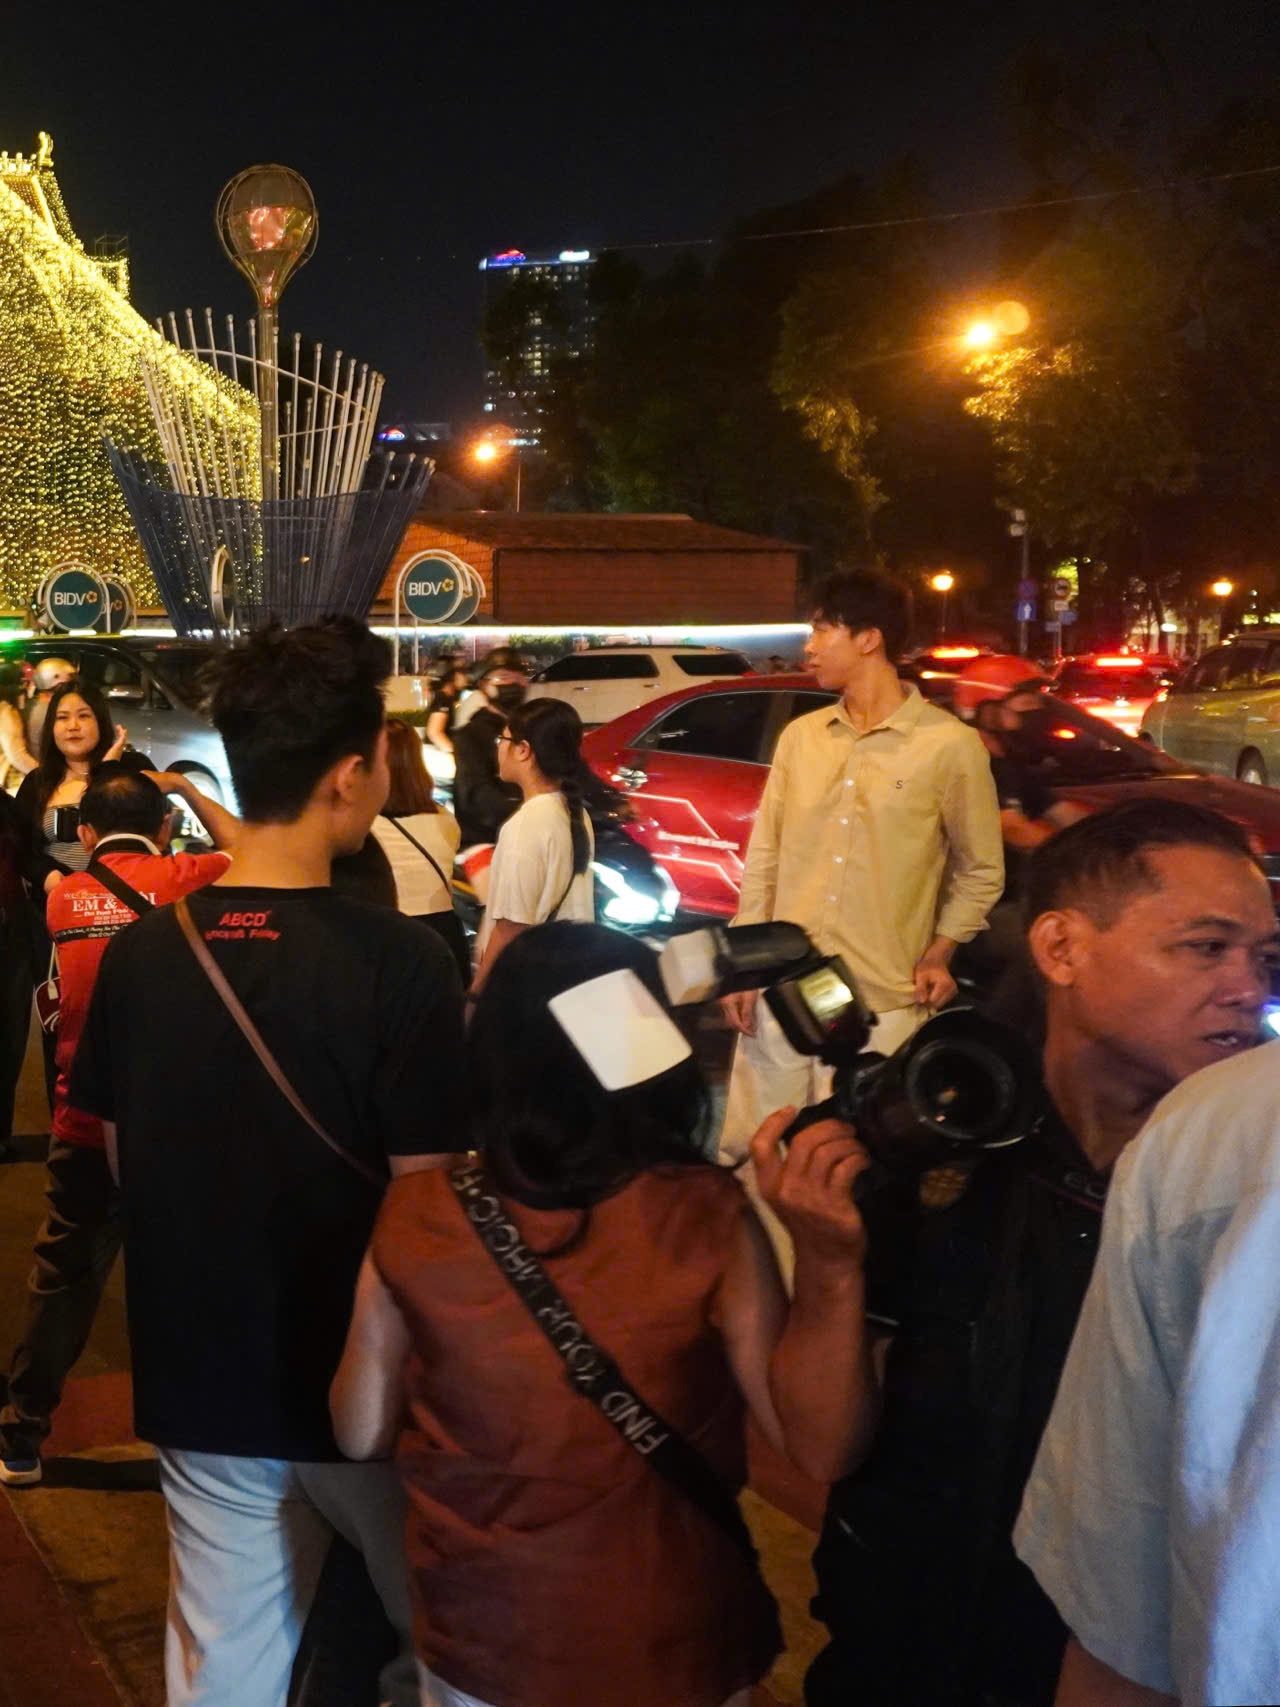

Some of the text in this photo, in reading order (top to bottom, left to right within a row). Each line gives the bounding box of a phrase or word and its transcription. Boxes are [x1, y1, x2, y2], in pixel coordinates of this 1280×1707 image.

[407, 582, 442, 596] BIDV
[54, 592, 87, 606] BIDV
[895, 779, 904, 790] S
[72, 899, 118, 912] EM &
[219, 912, 267, 926] ABCD
[537, 1299, 605, 1388] YOUR
[601, 1391, 669, 1454] FIND
